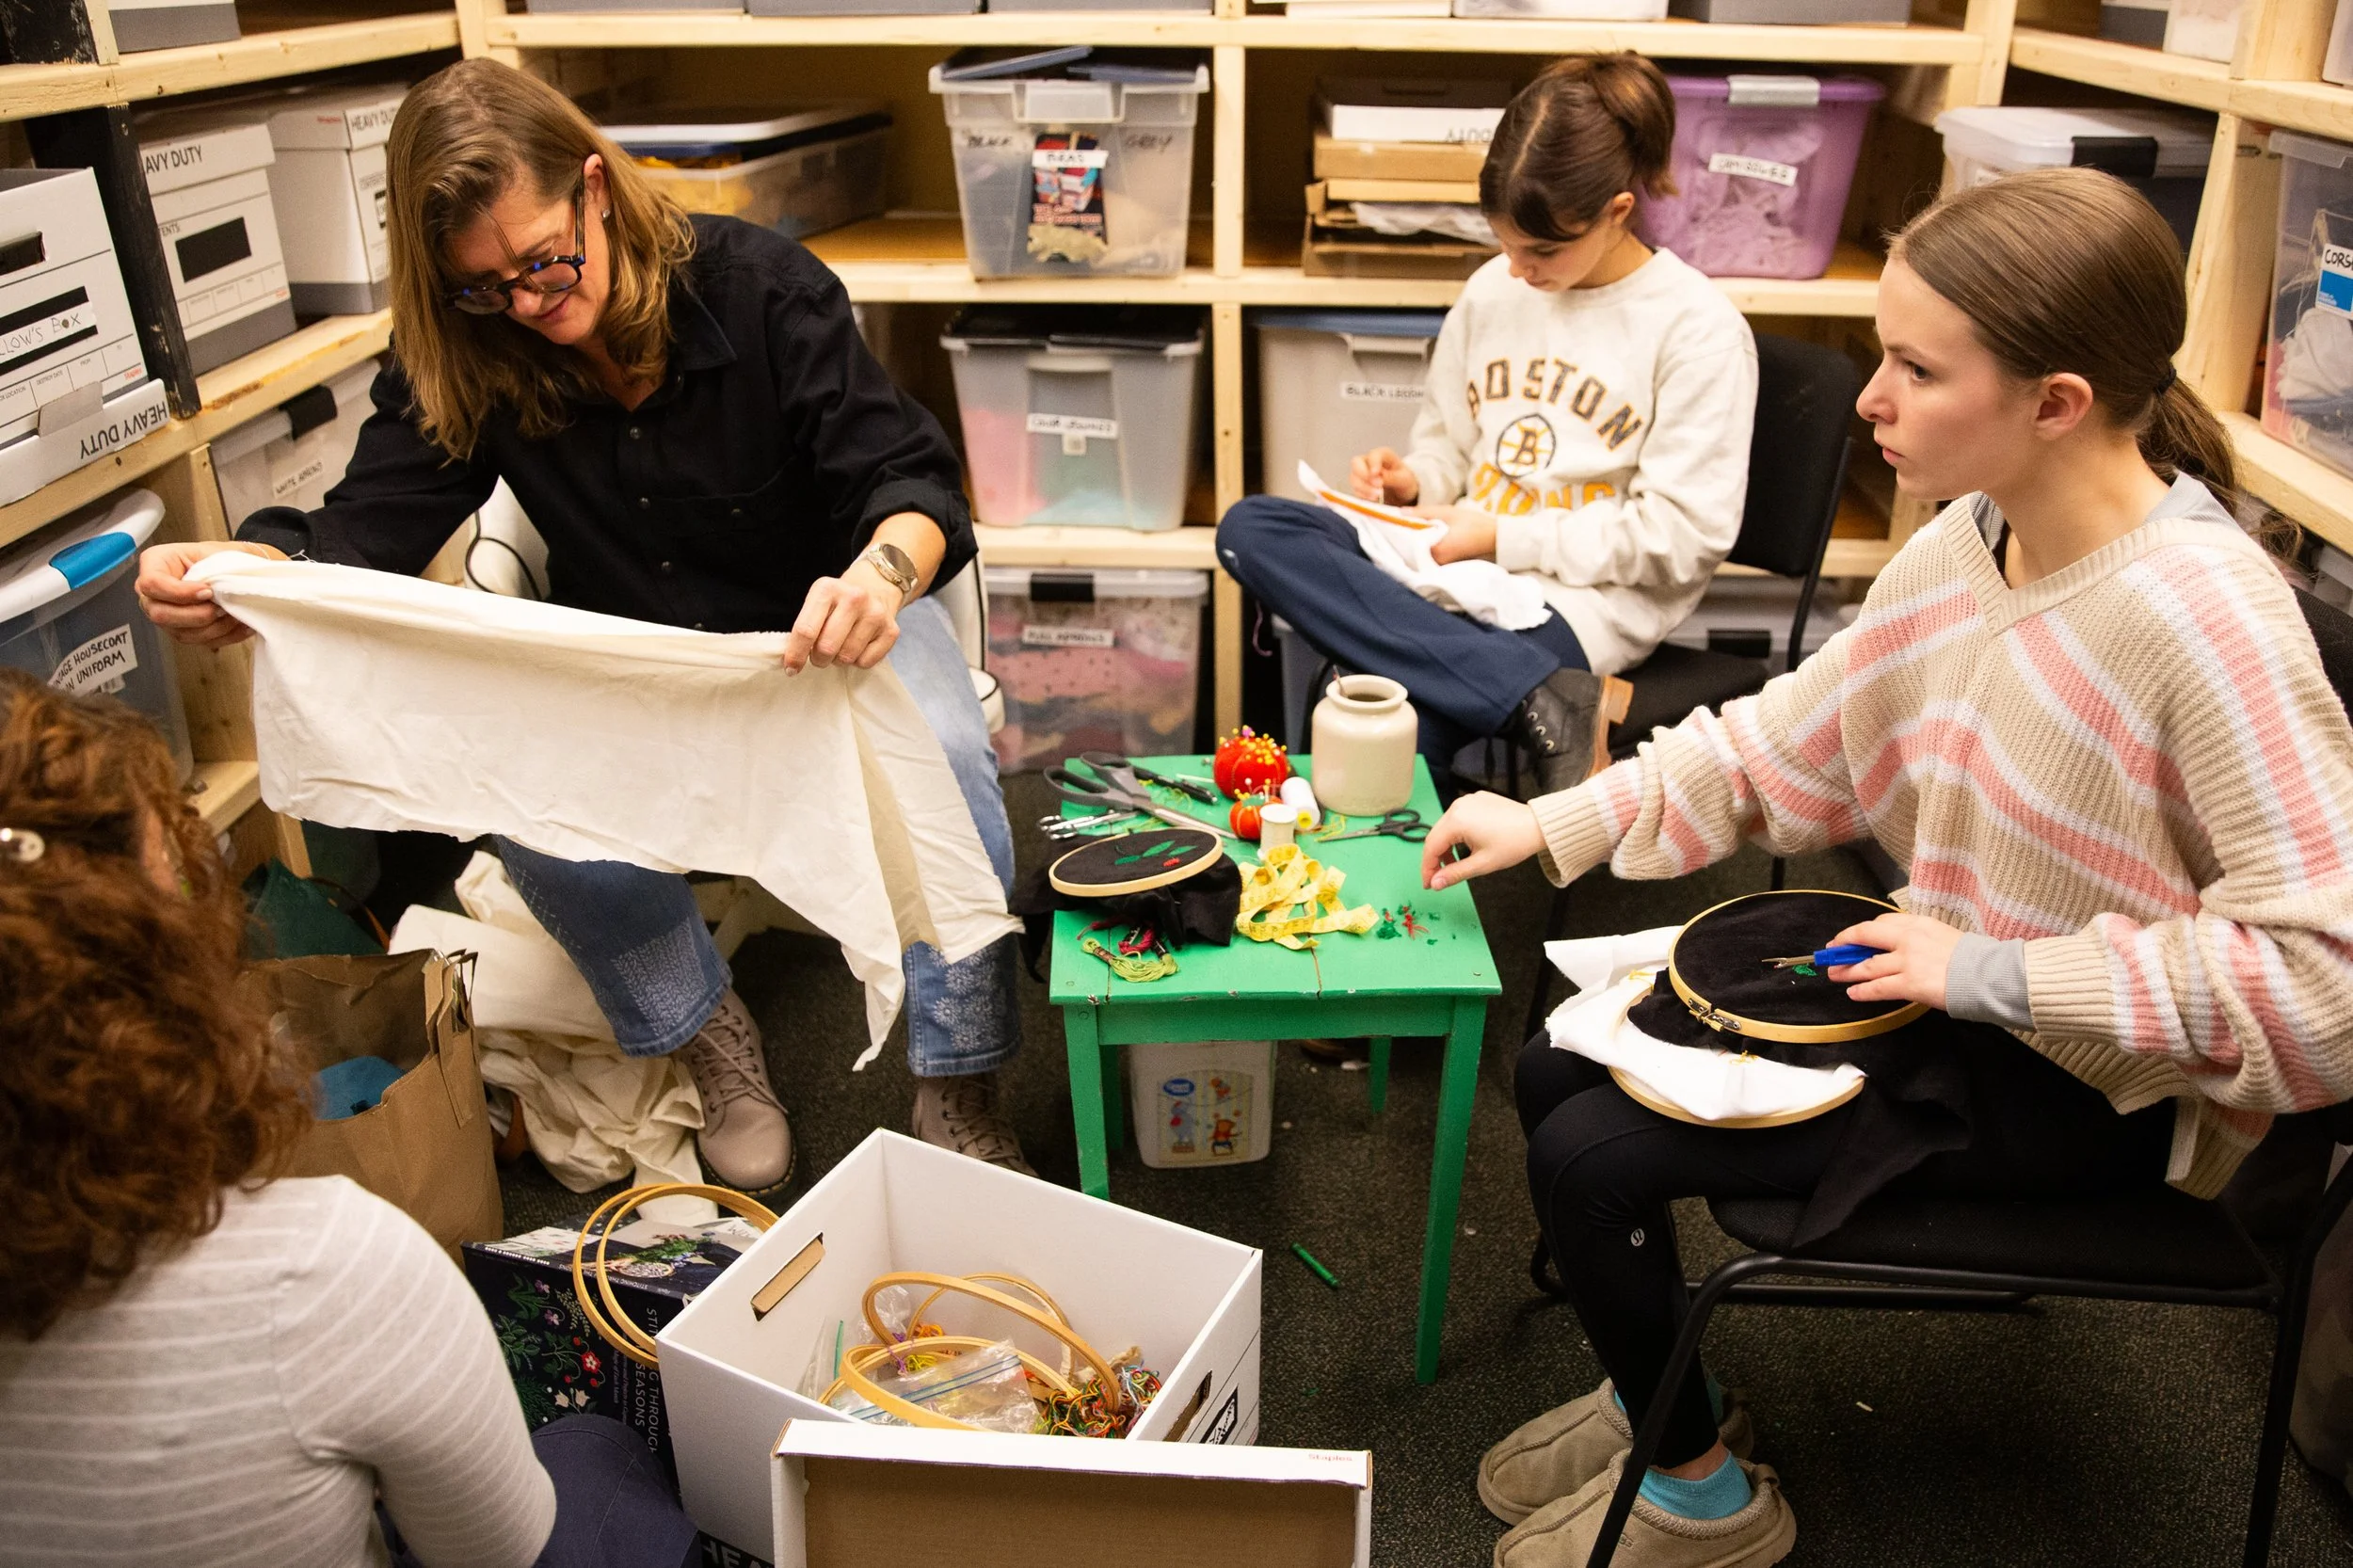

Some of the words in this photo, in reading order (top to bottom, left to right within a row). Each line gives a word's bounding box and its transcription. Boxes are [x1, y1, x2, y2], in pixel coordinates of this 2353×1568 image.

[171, 144, 203, 168] DUTY
[2325, 248, 2353, 271] CORS
[51, 312, 82, 334] BOX
[123, 401, 168, 439] HEAVY
[80, 424, 120, 459] DUTY
[72, 631, 127, 666] HOUSECOAT
[76, 649, 126, 684] UNIFORM
[634, 1362, 647, 1428] SEASONS
[1307, 1452, 1353, 1463] Staples
